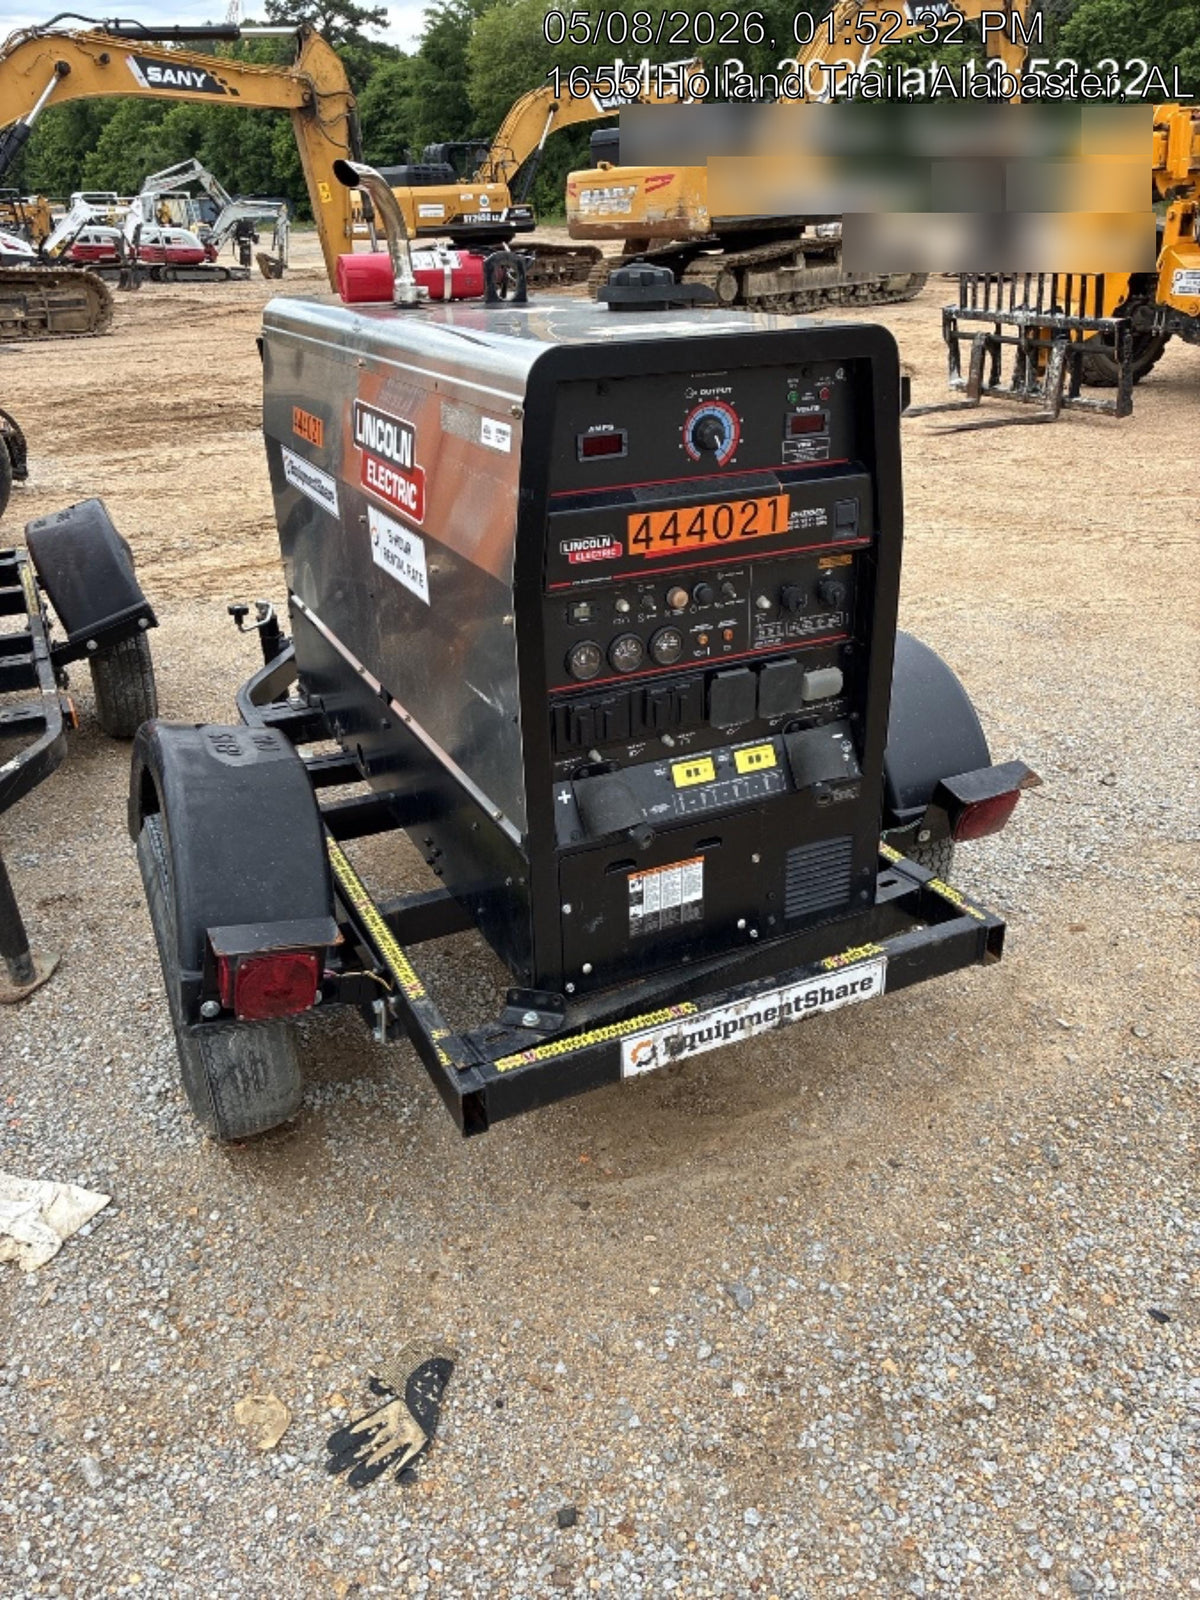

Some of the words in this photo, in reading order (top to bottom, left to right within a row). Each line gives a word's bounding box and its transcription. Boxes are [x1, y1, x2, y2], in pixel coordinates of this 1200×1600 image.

[147, 66, 206, 88] SANY
[700, 387, 733, 396] OUTPUT
[356, 408, 412, 469] LINCOLN
[366, 458, 418, 511] ELECTRIC
[632, 498, 778, 550] 444021
[563, 538, 611, 552] LINCOLN
[575, 548, 617, 561] ELECTRIC
[662, 974, 874, 1056] EquipmentShare
